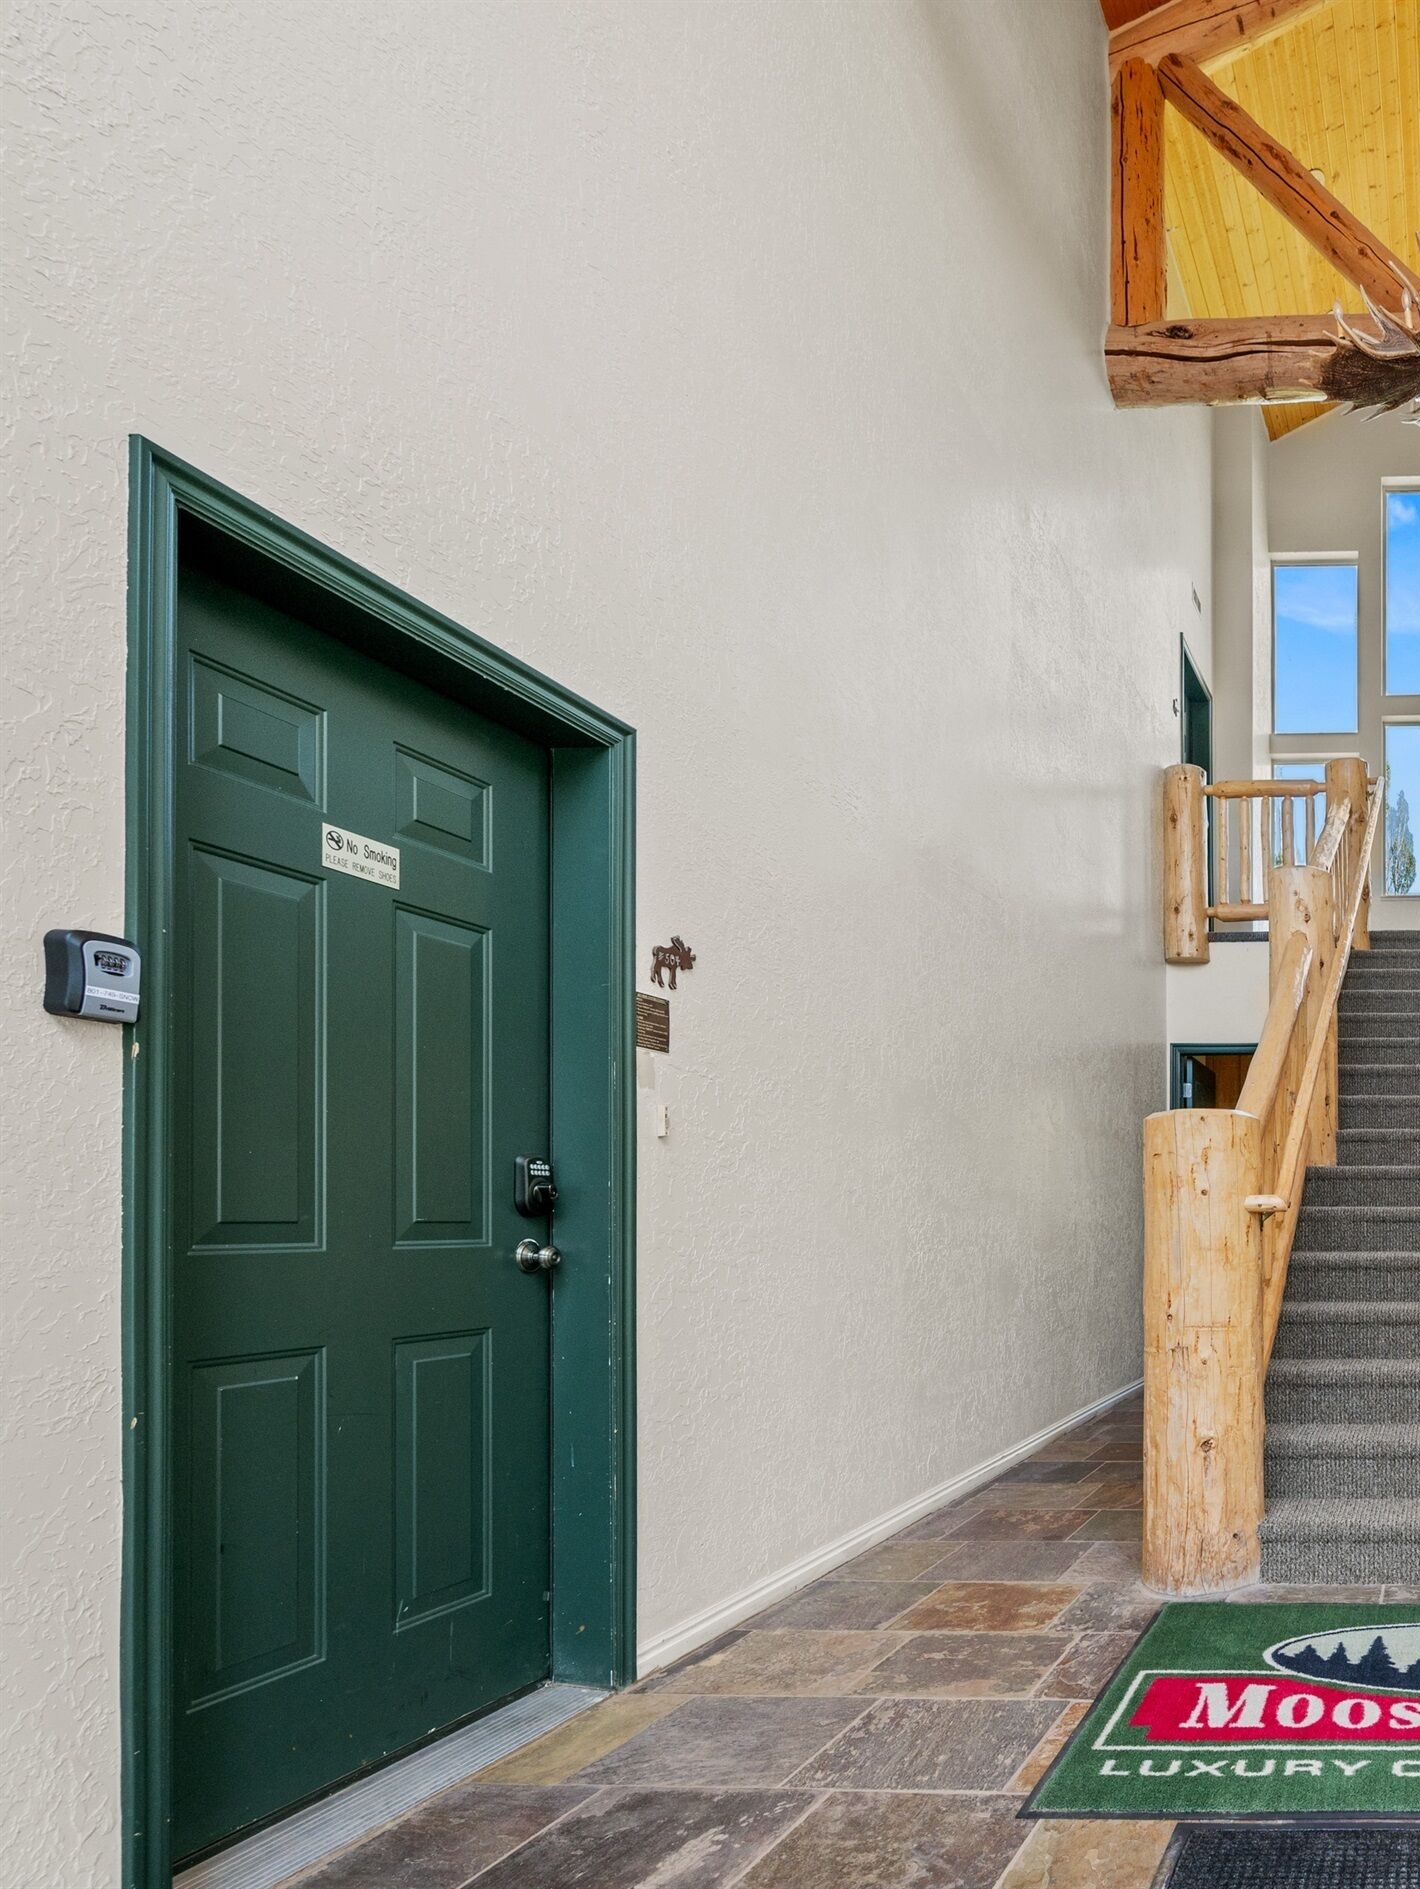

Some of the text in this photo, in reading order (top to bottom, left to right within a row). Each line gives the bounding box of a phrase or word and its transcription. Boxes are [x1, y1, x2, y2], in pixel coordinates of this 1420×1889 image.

[325, 853, 397, 884] PLEASE REMOVE SHOES
[346, 838, 397, 871] No Smoking
[1099, 1758, 1372, 1777] LUXURY
